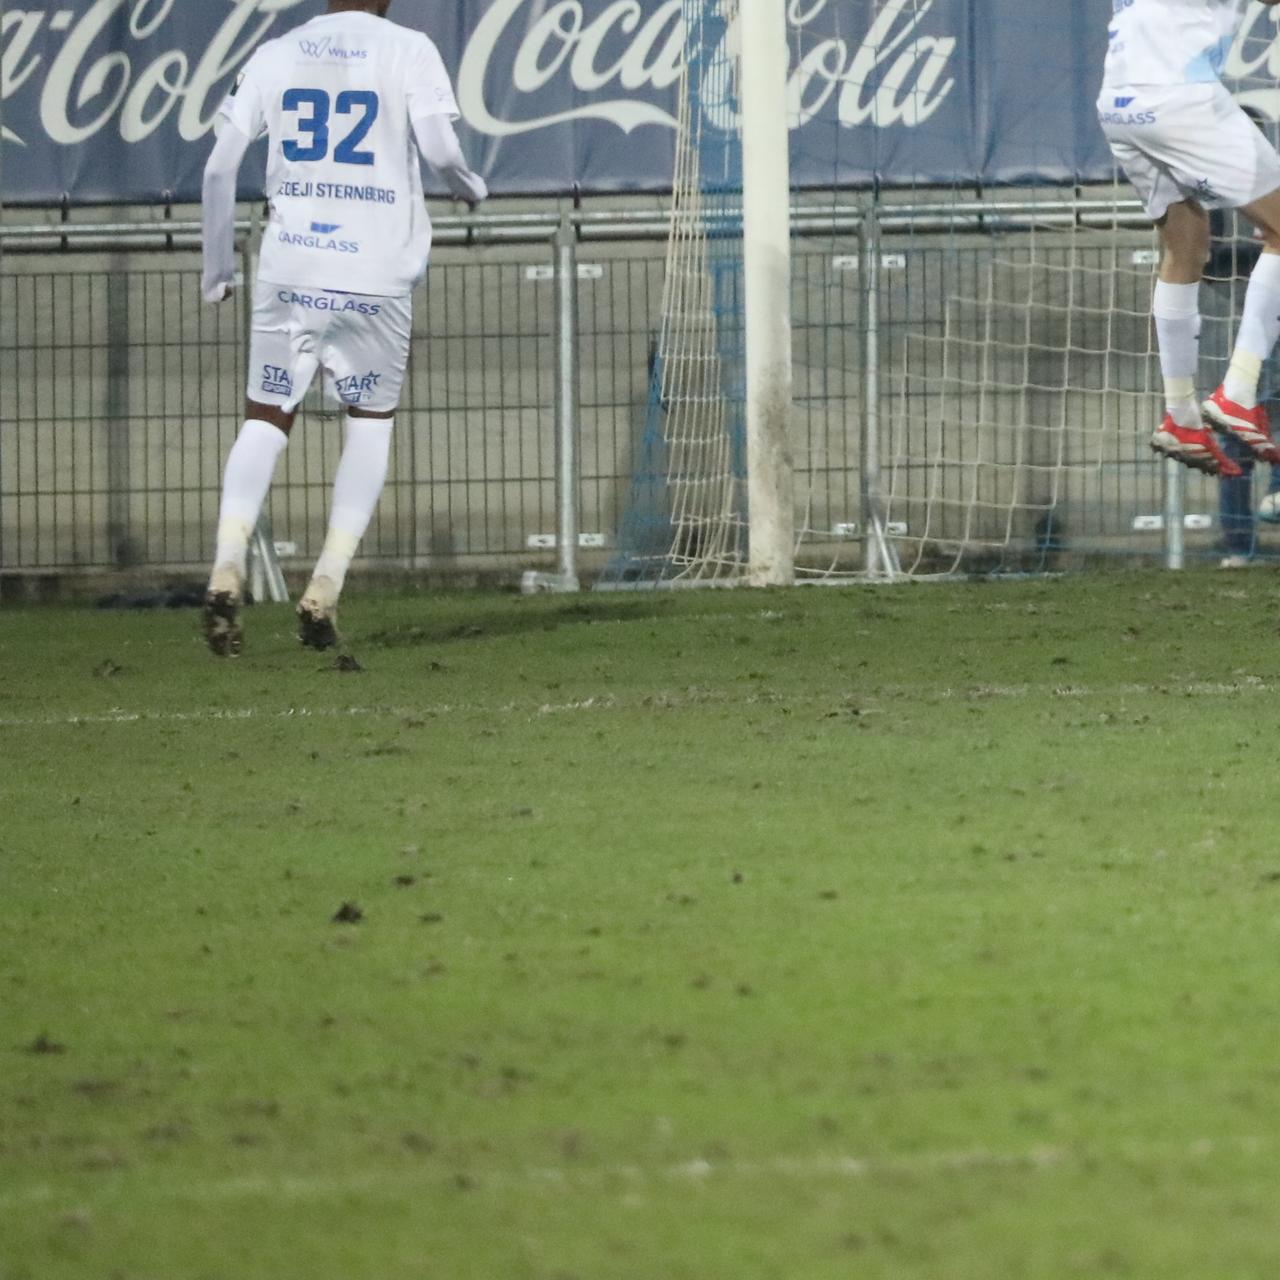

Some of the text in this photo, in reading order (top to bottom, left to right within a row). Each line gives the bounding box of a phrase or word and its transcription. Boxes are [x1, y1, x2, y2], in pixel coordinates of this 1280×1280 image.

[328, 47, 368, 59] WILMS
[281, 87, 380, 166] 32
[316, 182, 396, 205] STERNBERG
[277, 290, 381, 316] CARGLASS
[263, 364, 293, 386] STA
